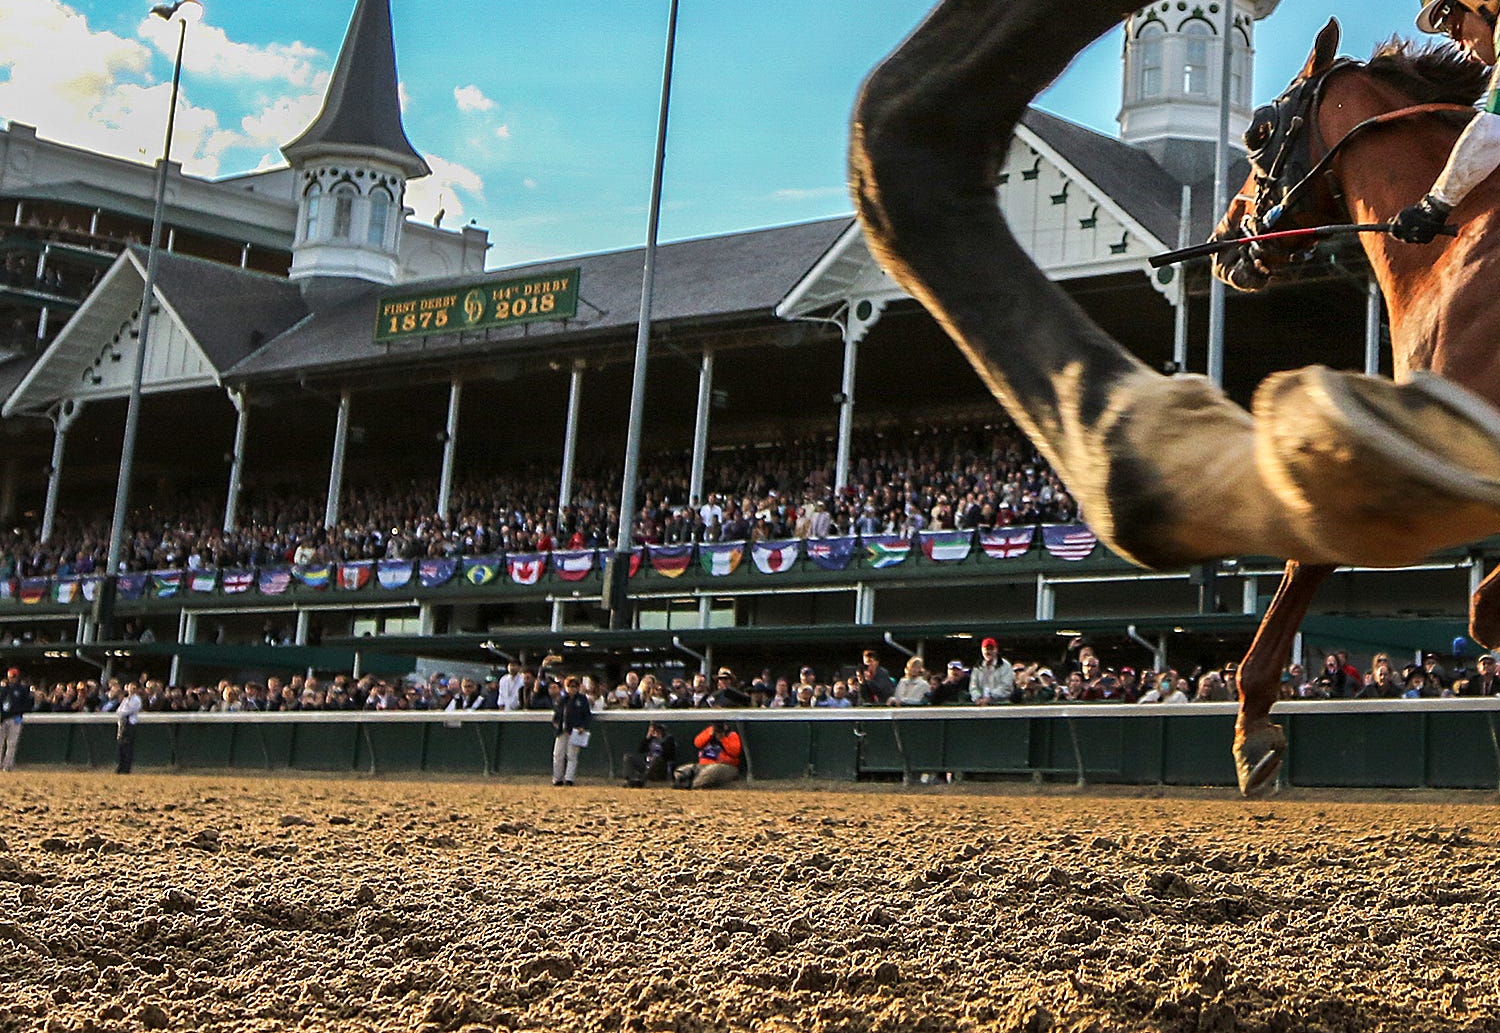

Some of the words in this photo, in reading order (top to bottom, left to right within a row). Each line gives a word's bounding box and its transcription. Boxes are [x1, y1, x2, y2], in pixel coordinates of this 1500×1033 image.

[524, 278, 569, 296] DERBY
[384, 300, 417, 316] FIRST
[421, 295, 457, 310] DERBY
[495, 293, 555, 319] 2018
[389, 309, 448, 333] 1875
